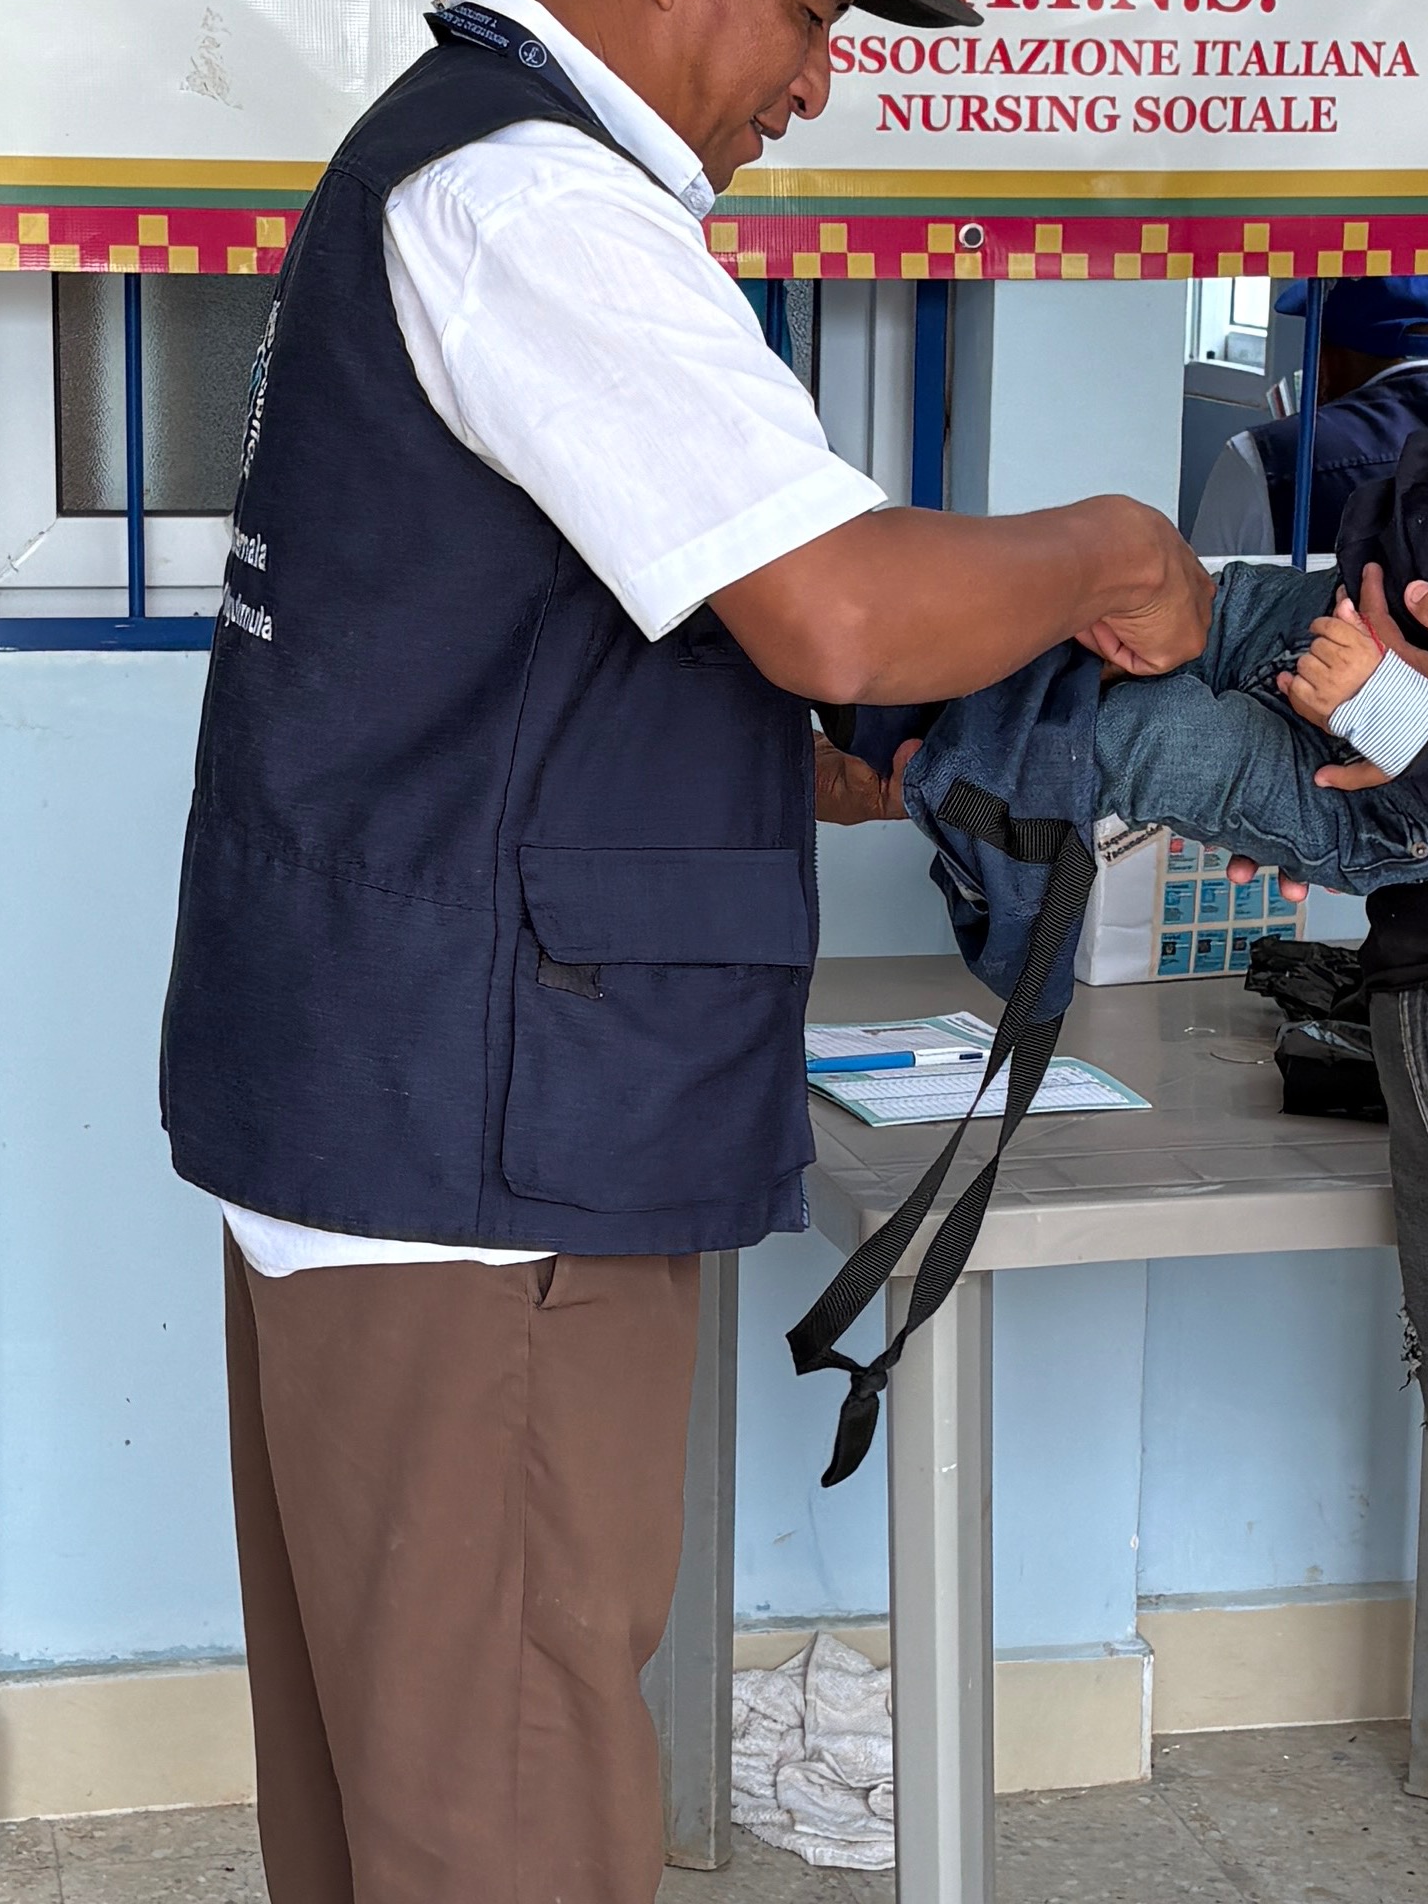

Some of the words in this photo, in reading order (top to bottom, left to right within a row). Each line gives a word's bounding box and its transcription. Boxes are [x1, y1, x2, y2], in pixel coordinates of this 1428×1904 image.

[828, 35, 1180, 76] SSOCIAZIONE
[1195, 39, 1419, 78] ITALIANA
[877, 94, 1120, 133] NURSING
[1133, 96, 1338, 134] SOCIALE
